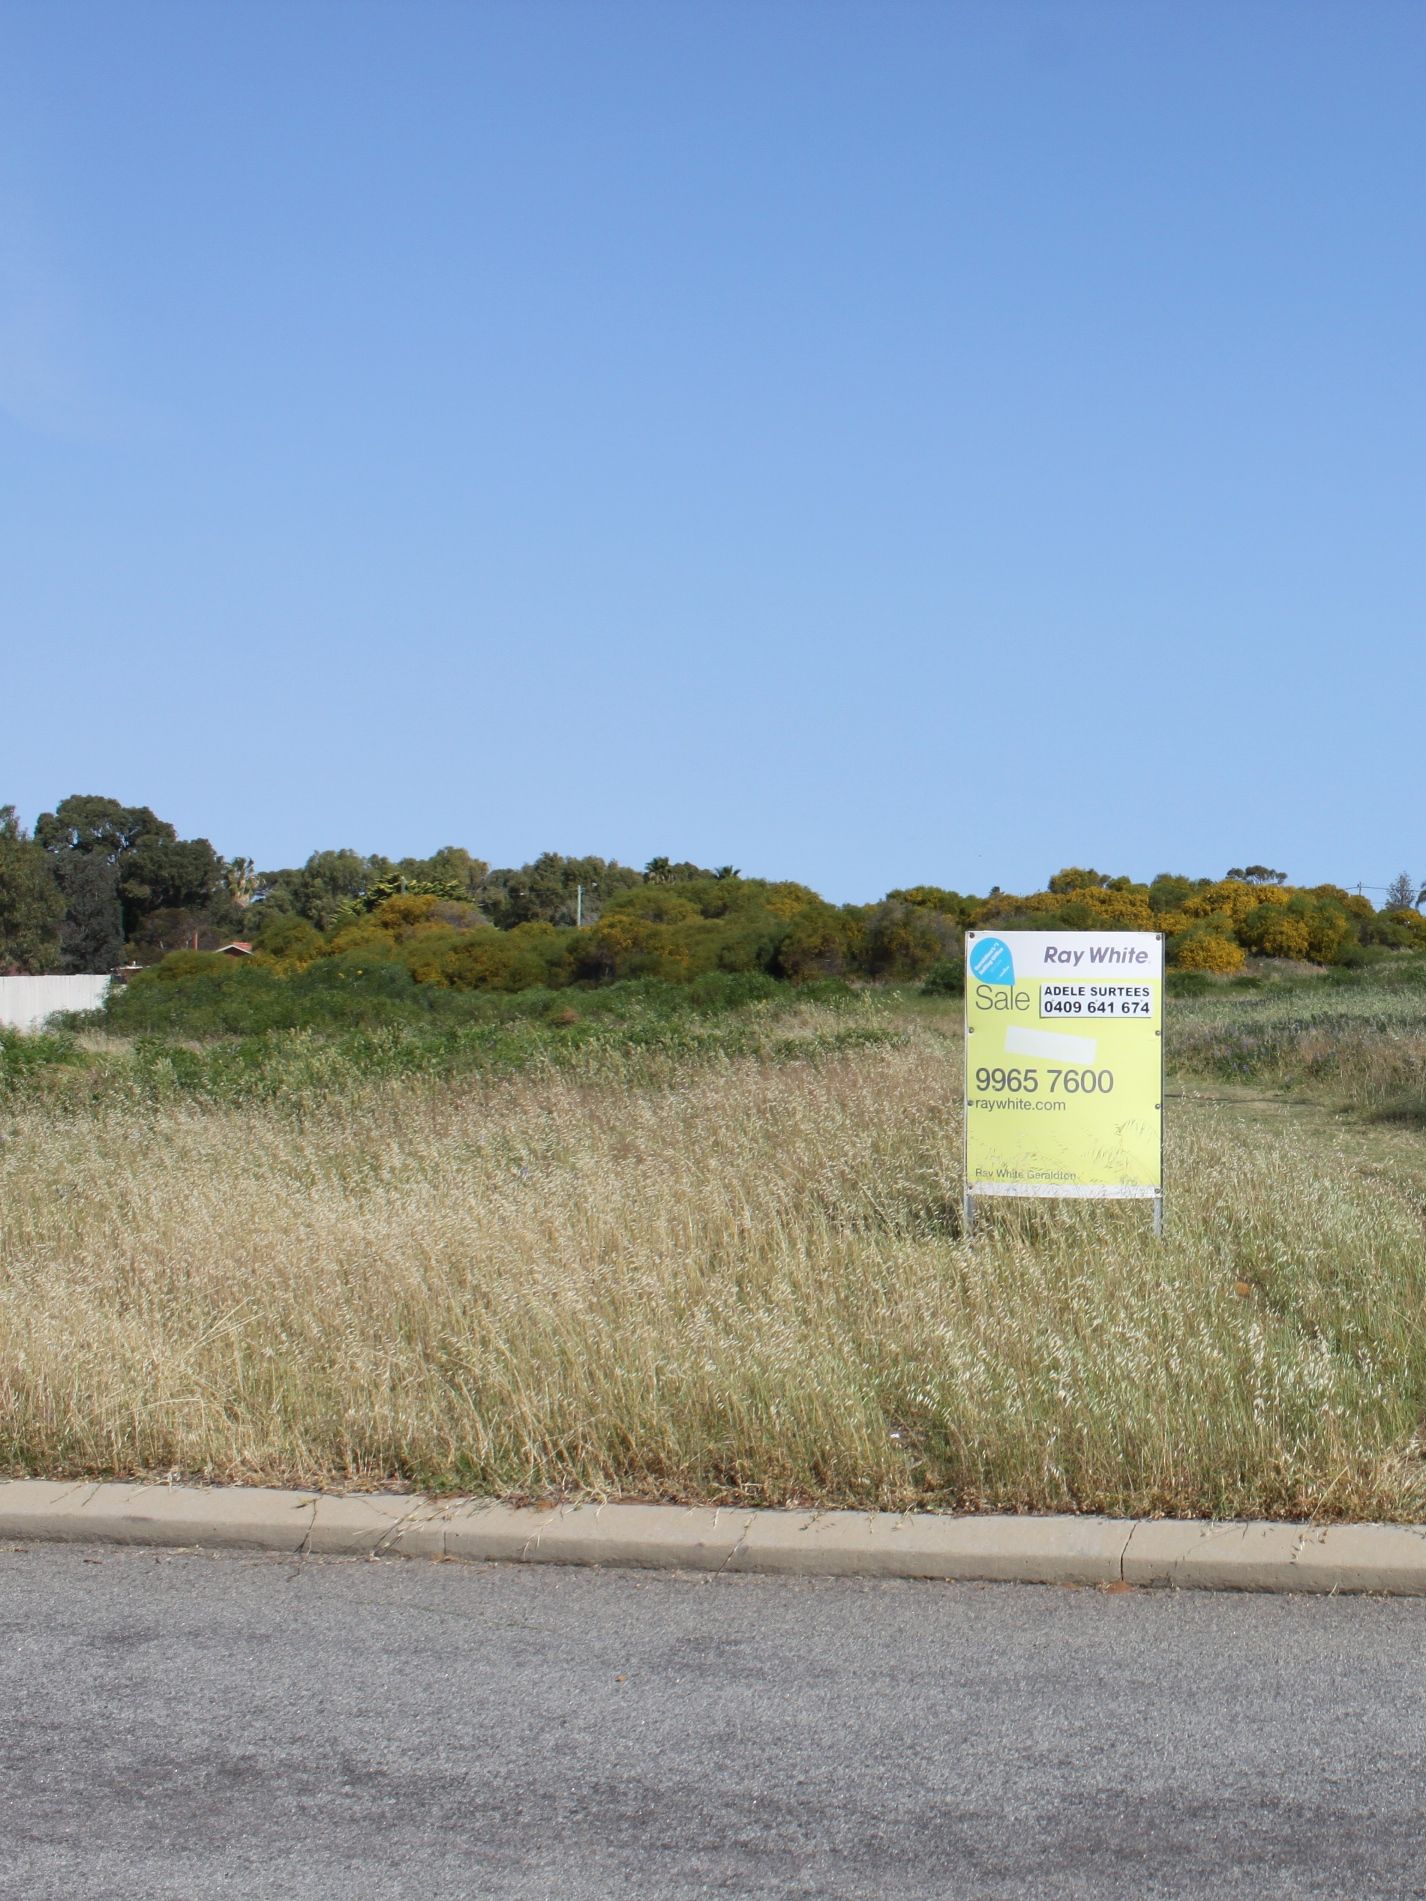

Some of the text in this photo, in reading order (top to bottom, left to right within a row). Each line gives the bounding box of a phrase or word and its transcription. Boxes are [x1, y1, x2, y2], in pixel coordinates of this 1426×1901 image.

[1044, 946, 1148, 967] Ray White
[975, 985, 1031, 1011] Sale
[1044, 986, 1150, 997] ADELE SURTEES
[1044, 1001, 1150, 1014] 0409 641 674
[975, 1068, 1114, 1093] 9965 7600
[975, 1097, 1066, 1112] raywhite.com
[996, 1168, 1023, 1179] White
[1027, 1169, 1077, 1180] Geraldton
